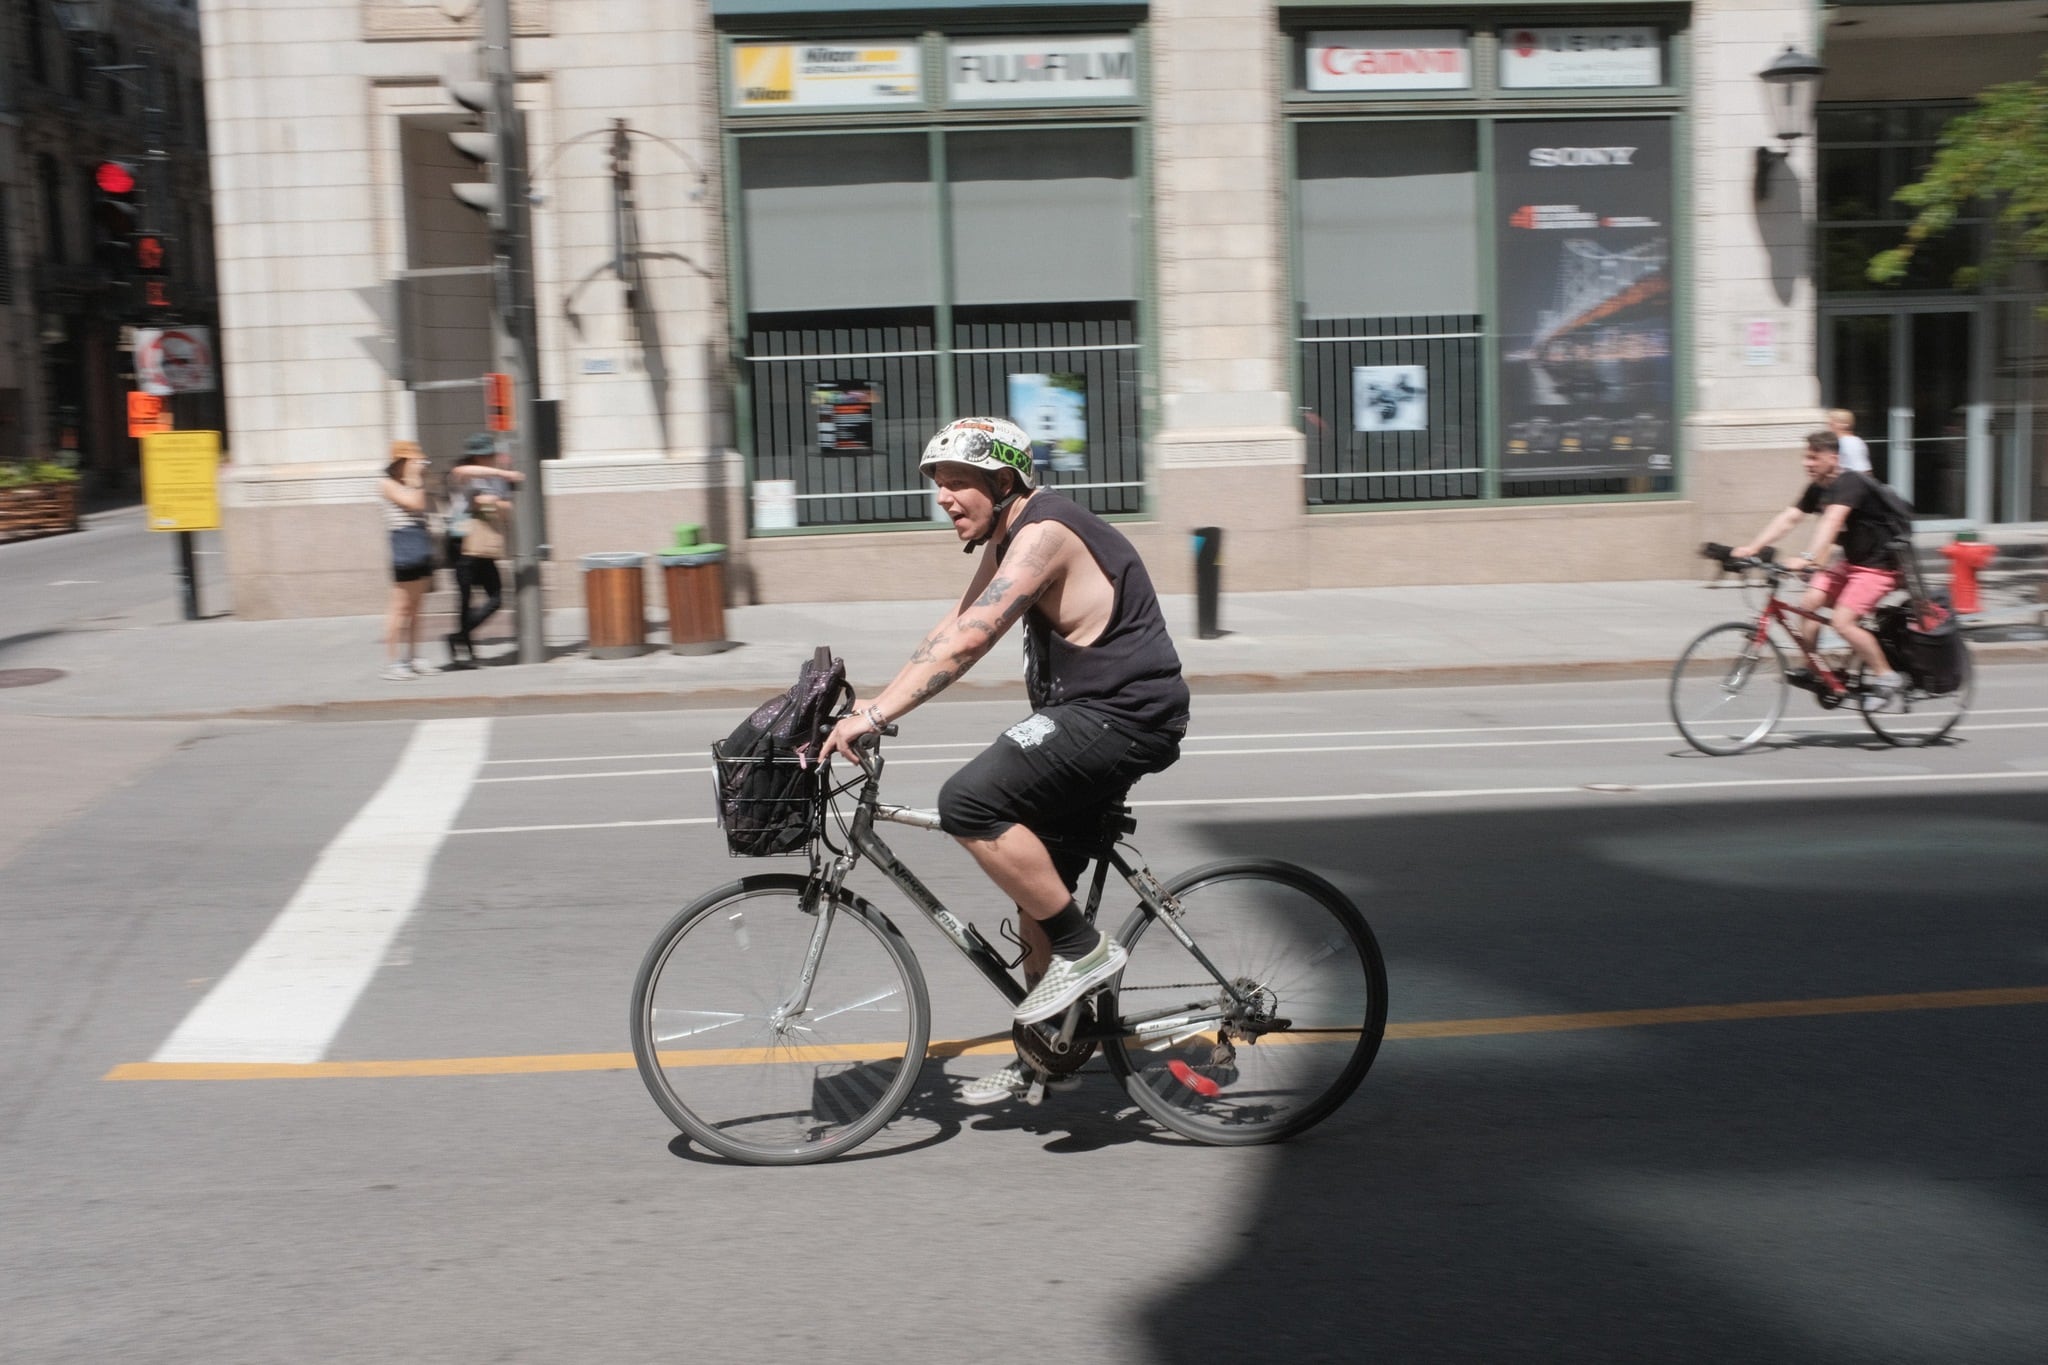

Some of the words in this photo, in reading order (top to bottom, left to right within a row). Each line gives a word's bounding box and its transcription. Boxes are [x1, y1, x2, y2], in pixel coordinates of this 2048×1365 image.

[952, 53, 1134, 83] FUJIFILM
[1322, 46, 1462, 75] Canon
[1529, 146, 1638, 167] SONY
[990, 440, 1031, 475] NOFX
